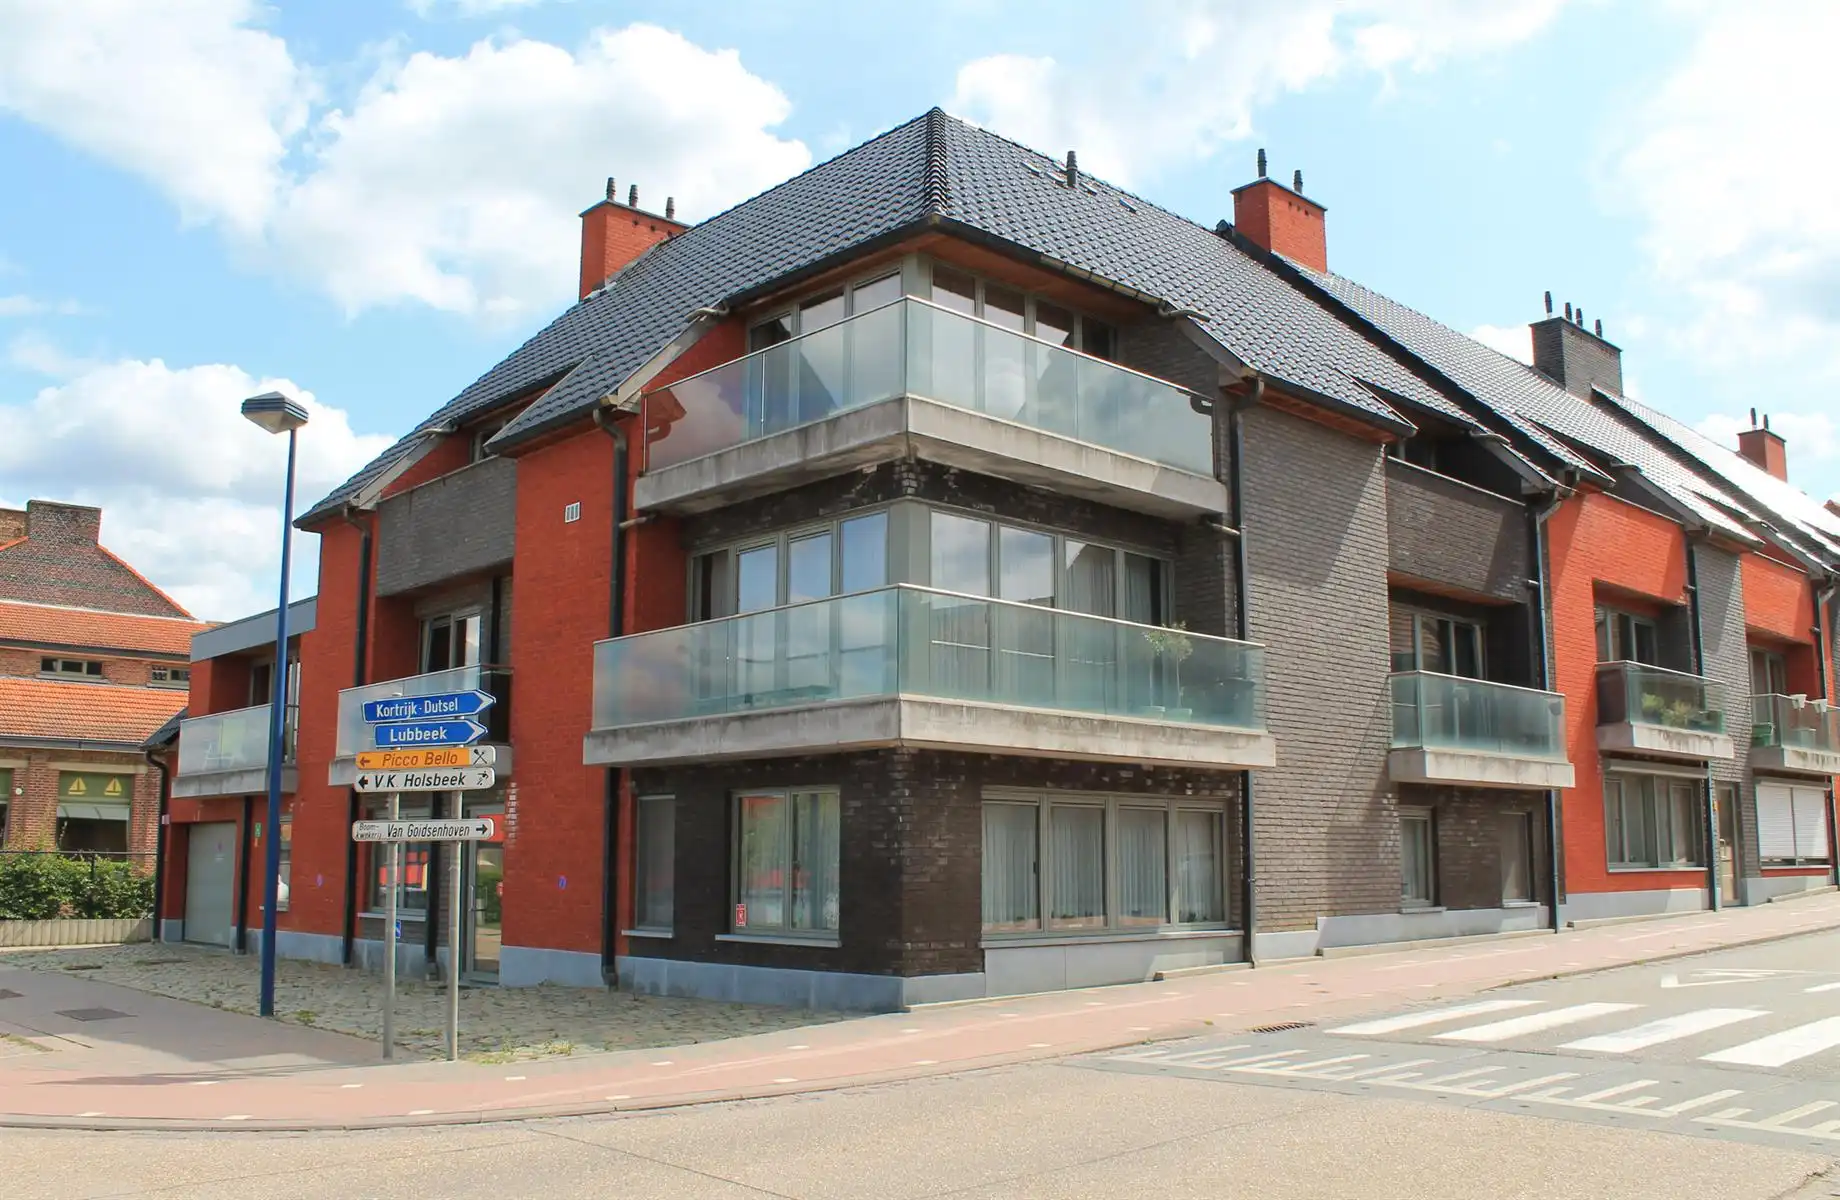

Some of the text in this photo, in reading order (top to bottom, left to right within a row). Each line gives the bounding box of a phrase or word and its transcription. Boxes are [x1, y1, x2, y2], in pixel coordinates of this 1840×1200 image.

[390, 726, 447, 742] Lubbeek
[382, 751, 458, 767] Picco Bello
[404, 772, 466, 787] Holsbeek
[387, 823, 470, 838] Van Goidsenhoven
